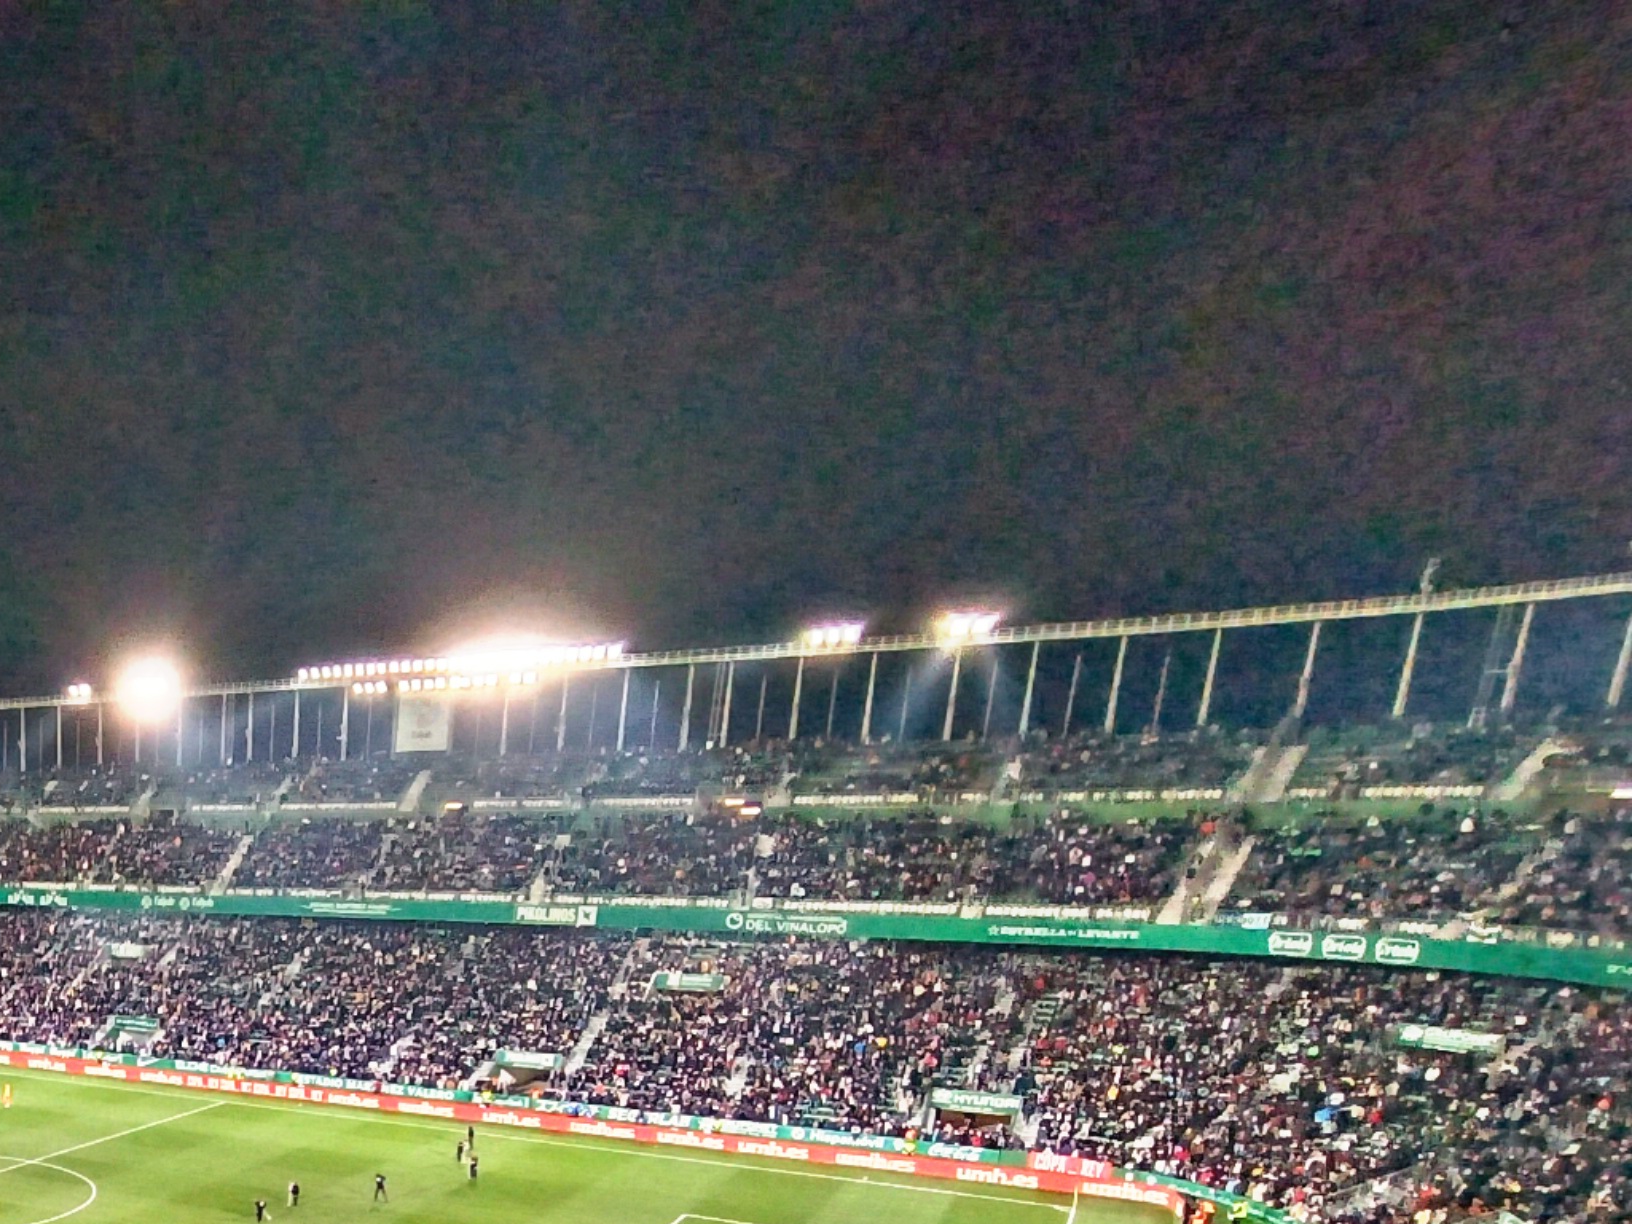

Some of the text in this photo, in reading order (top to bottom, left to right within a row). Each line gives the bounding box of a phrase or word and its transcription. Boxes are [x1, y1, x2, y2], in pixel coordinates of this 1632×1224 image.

[656, 1129, 725, 1151] umh.es
[737, 1140, 809, 1161] umh.es
[1033, 1151, 1106, 1179] COPA REY
[956, 1165, 1039, 1190] umh.es
